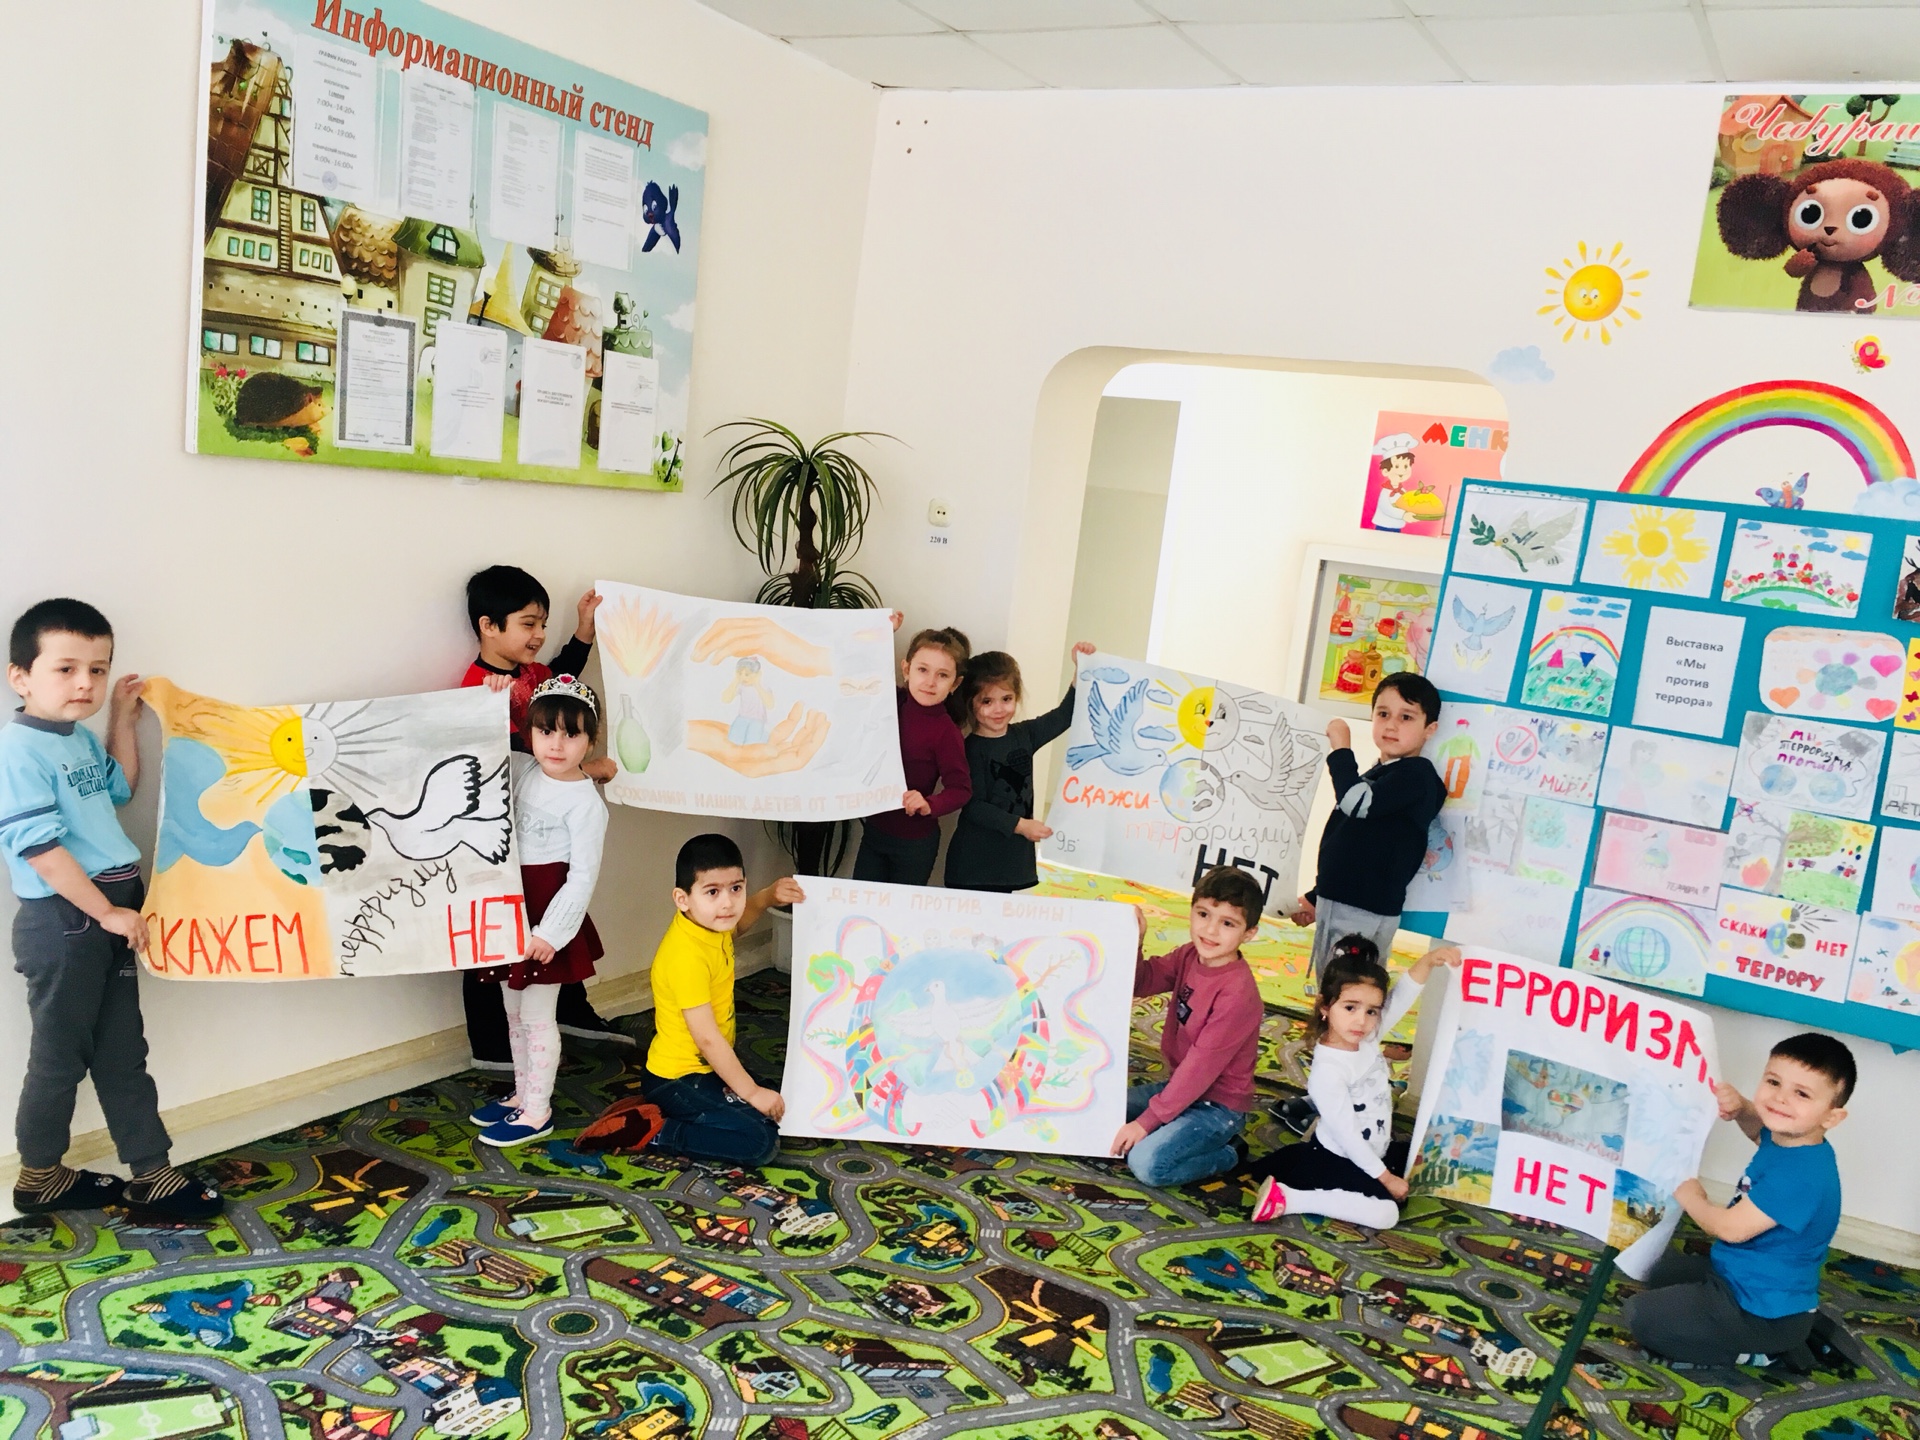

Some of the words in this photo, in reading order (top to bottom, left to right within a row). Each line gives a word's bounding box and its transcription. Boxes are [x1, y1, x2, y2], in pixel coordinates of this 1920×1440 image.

[311, 0, 584, 122] Информационный
[589, 99, 655, 151] стенд
[930, 536, 941, 544] 220
[1666, 636, 1724, 652] Выставка
[1676, 658, 1706, 670] «Мы
[1666, 676, 1710, 689] против
[1655, 692, 1713, 708] террора»
[1487, 759, 1541, 780] ЕРРОРУ!
[613, 784, 687, 807] СОХРАНИМ
[695, 792, 748, 811] НАШИХ
[751, 794, 801, 815] ДЕТЕЙ
[808, 796, 826, 812] ОТ
[835, 784, 901, 811] ТЕРРОРА
[827, 886, 891, 906] ДЕТИ
[910, 893, 983, 915] ПРОТИВ
[145, 911, 310, 976] СКАЖЕМ
[447, 894, 526, 968] НЕТ
[1719, 918, 1768, 939] СКАЖИ
[1815, 939, 1848, 957] НЕТ
[1736, 956, 1825, 992] ТЕРРОРУ
[1460, 957, 1717, 1094] ЕРРОРИЗМ
[1513, 1156, 1607, 1214] НЕТ
